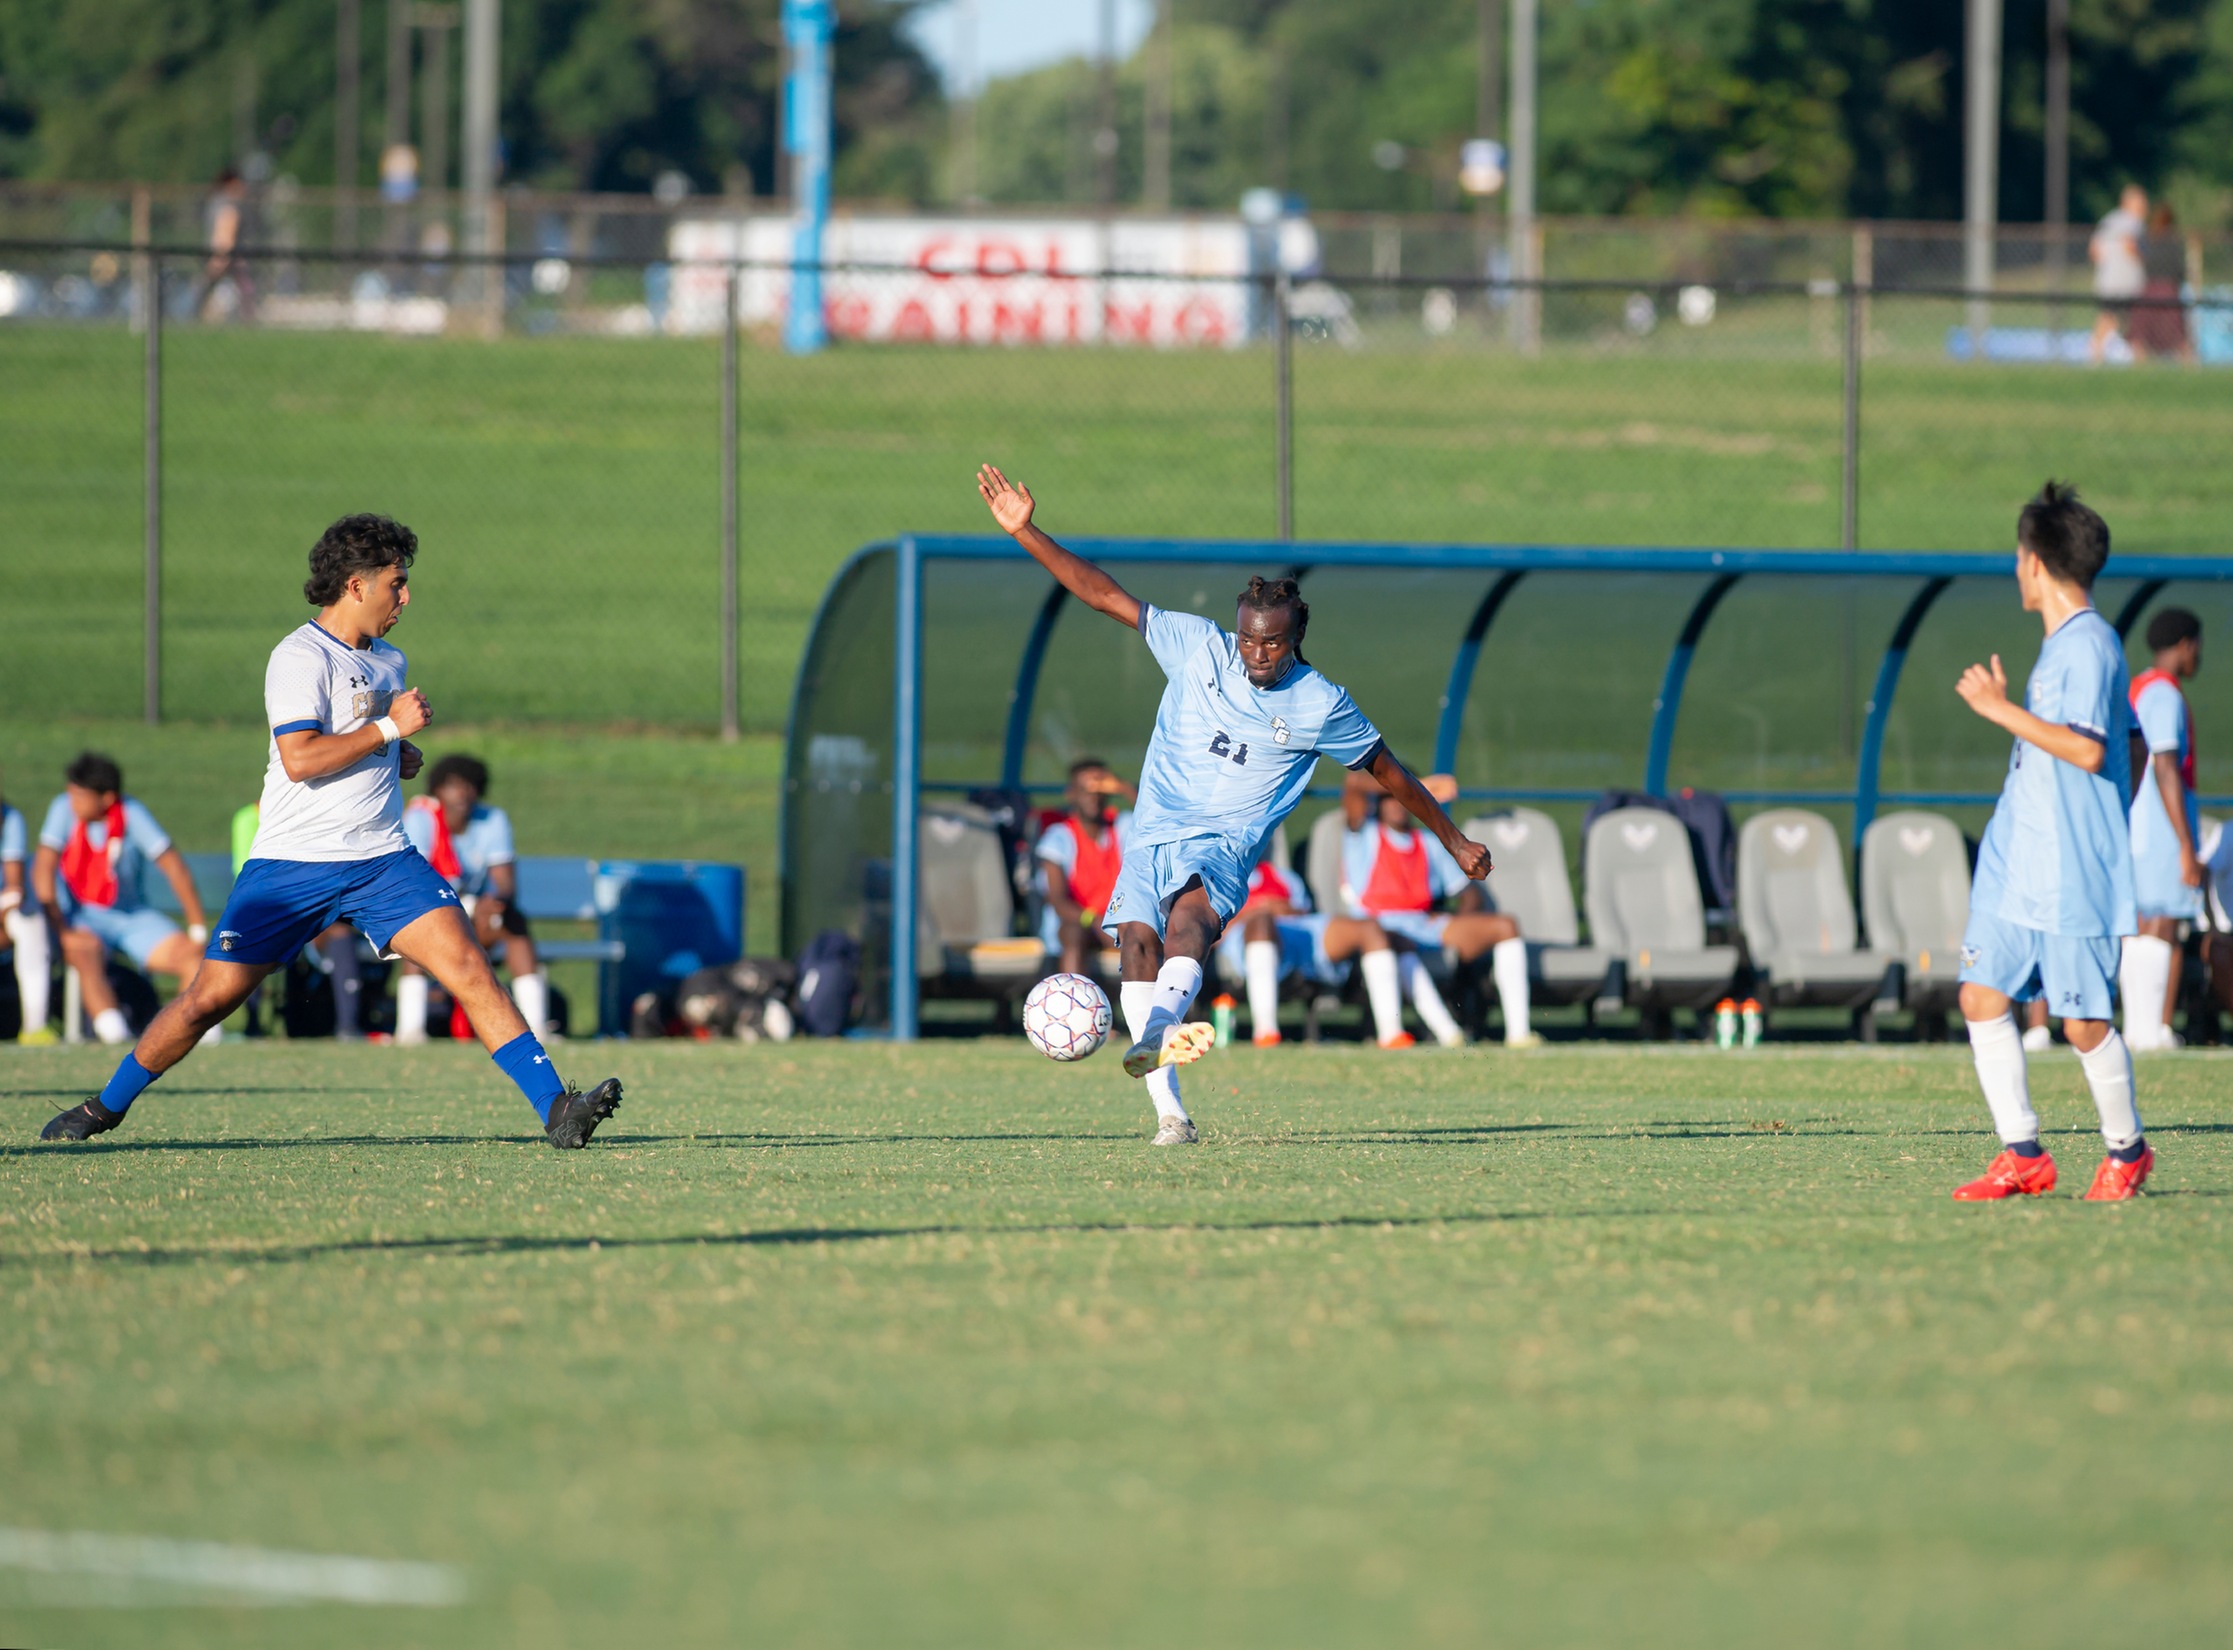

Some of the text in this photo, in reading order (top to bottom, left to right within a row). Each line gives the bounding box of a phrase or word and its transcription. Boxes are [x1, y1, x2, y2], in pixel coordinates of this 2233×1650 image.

[914, 234, 1079, 281] CDL
[772, 294, 1230, 344] RAINING
[1208, 729, 1249, 766] 21
